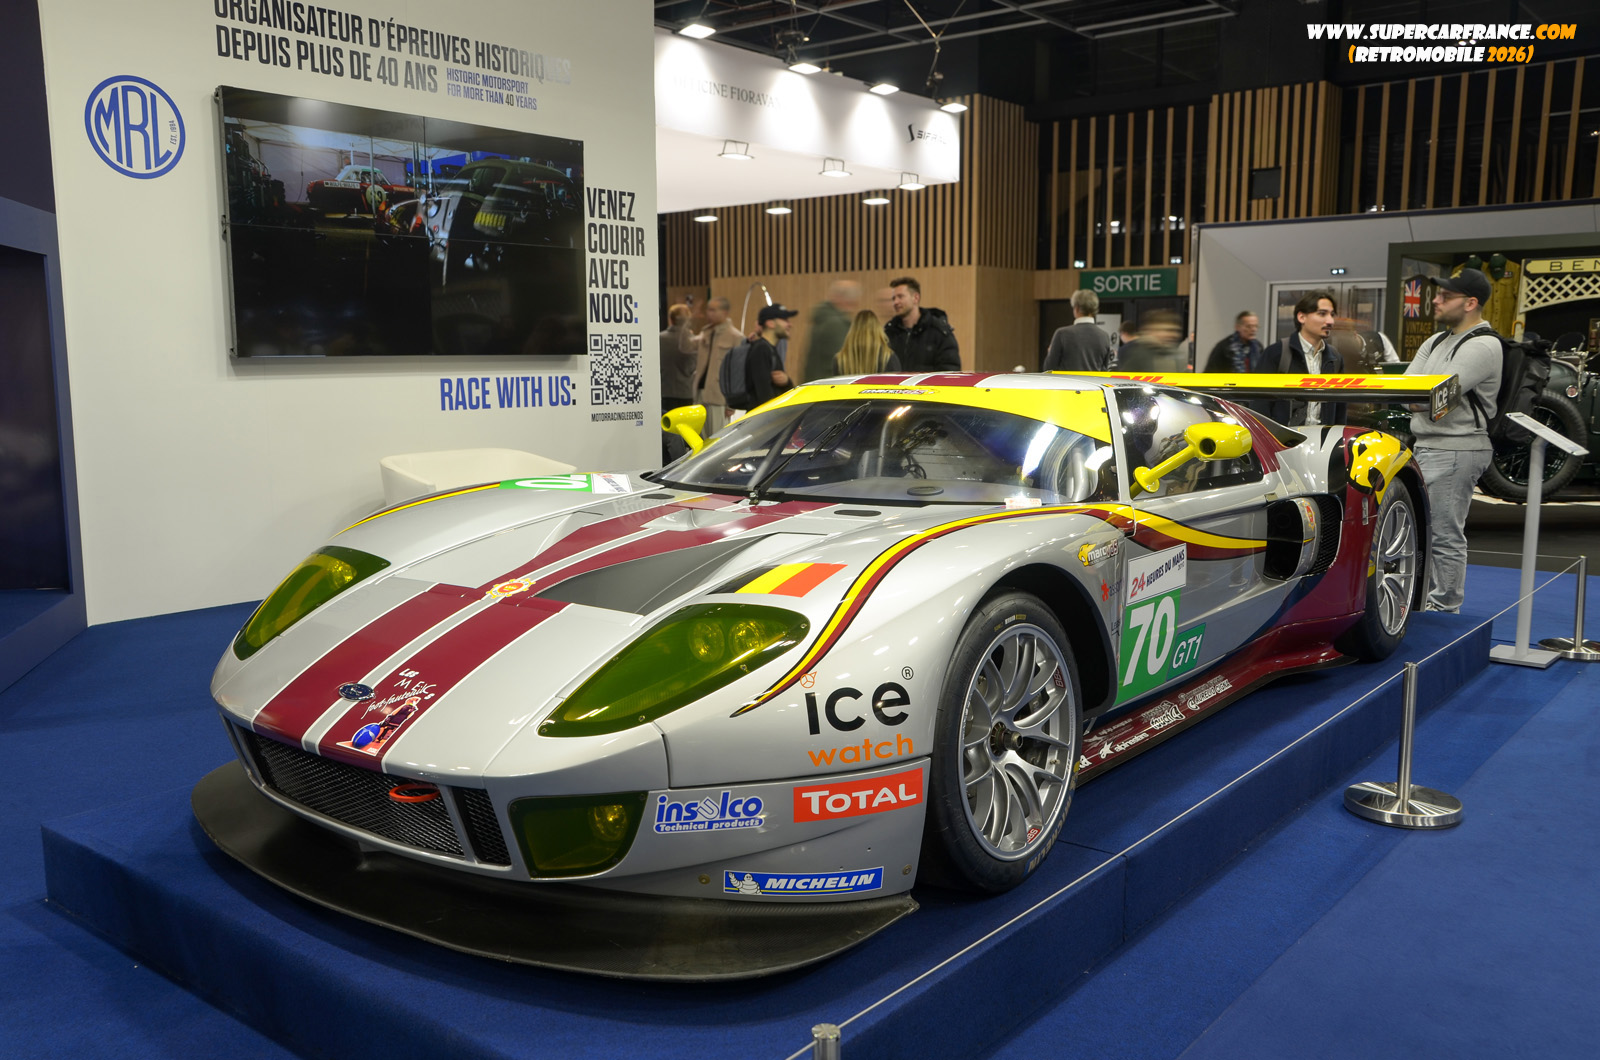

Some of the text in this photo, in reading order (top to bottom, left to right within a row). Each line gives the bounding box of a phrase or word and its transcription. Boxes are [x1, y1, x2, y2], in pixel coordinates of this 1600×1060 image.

[214, 0, 364, 46] ORGANISATEUR
[368, 17, 471, 66] D'ÉPREUVES
[215, 24, 438, 94] DEPUIS PLUS DE 40 ANS
[446, 67, 529, 95] HISTORIC MOTORSPORT
[447, 83, 538, 110] FOR MORE THAN 40 YEARS
[730, 86, 779, 108] FIORAVA
[94, 84, 173, 171] MRL
[586, 187, 636, 222] VENEZ
[587, 222, 645, 257] COURIR
[588, 258, 629, 290] AVEC
[1093, 273, 1162, 293] SORTIE
[589, 292, 639, 324] NOUS:
[1424, 285, 1432, 317] 8
[440, 375, 577, 411] RACE WITH US:
[1299, 377, 1368, 388] DHL
[591, 411, 644, 423] MOTORRACINGLEGENDS
[1130, 549, 1185, 599] 24 HEURES DU MANS
[1122, 596, 1203, 687] 70 GT1
[803, 678, 911, 736] ice
[807, 733, 914, 767] watch
[656, 791, 763, 823] insulco
[801, 783, 917, 815] TOTAL
[659, 819, 760, 832] Technical products
[765, 873, 876, 890] MICHELIN
